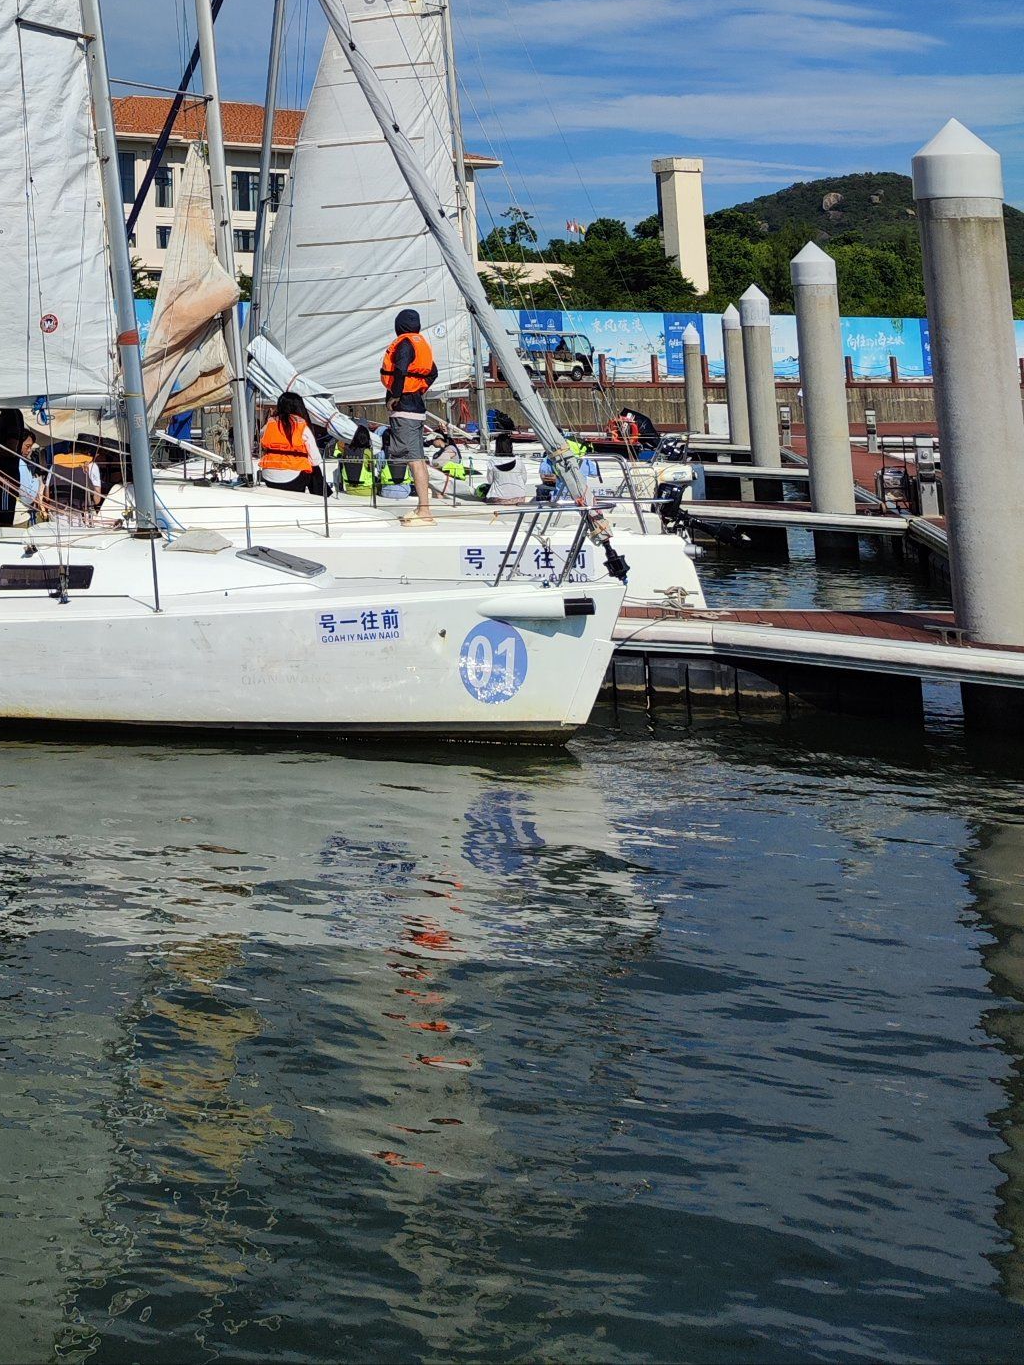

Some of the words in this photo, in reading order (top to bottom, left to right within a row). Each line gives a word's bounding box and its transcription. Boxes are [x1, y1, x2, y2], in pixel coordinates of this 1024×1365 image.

[319, 609, 399, 633] 号一往前
[466, 635, 516, 691] 01
